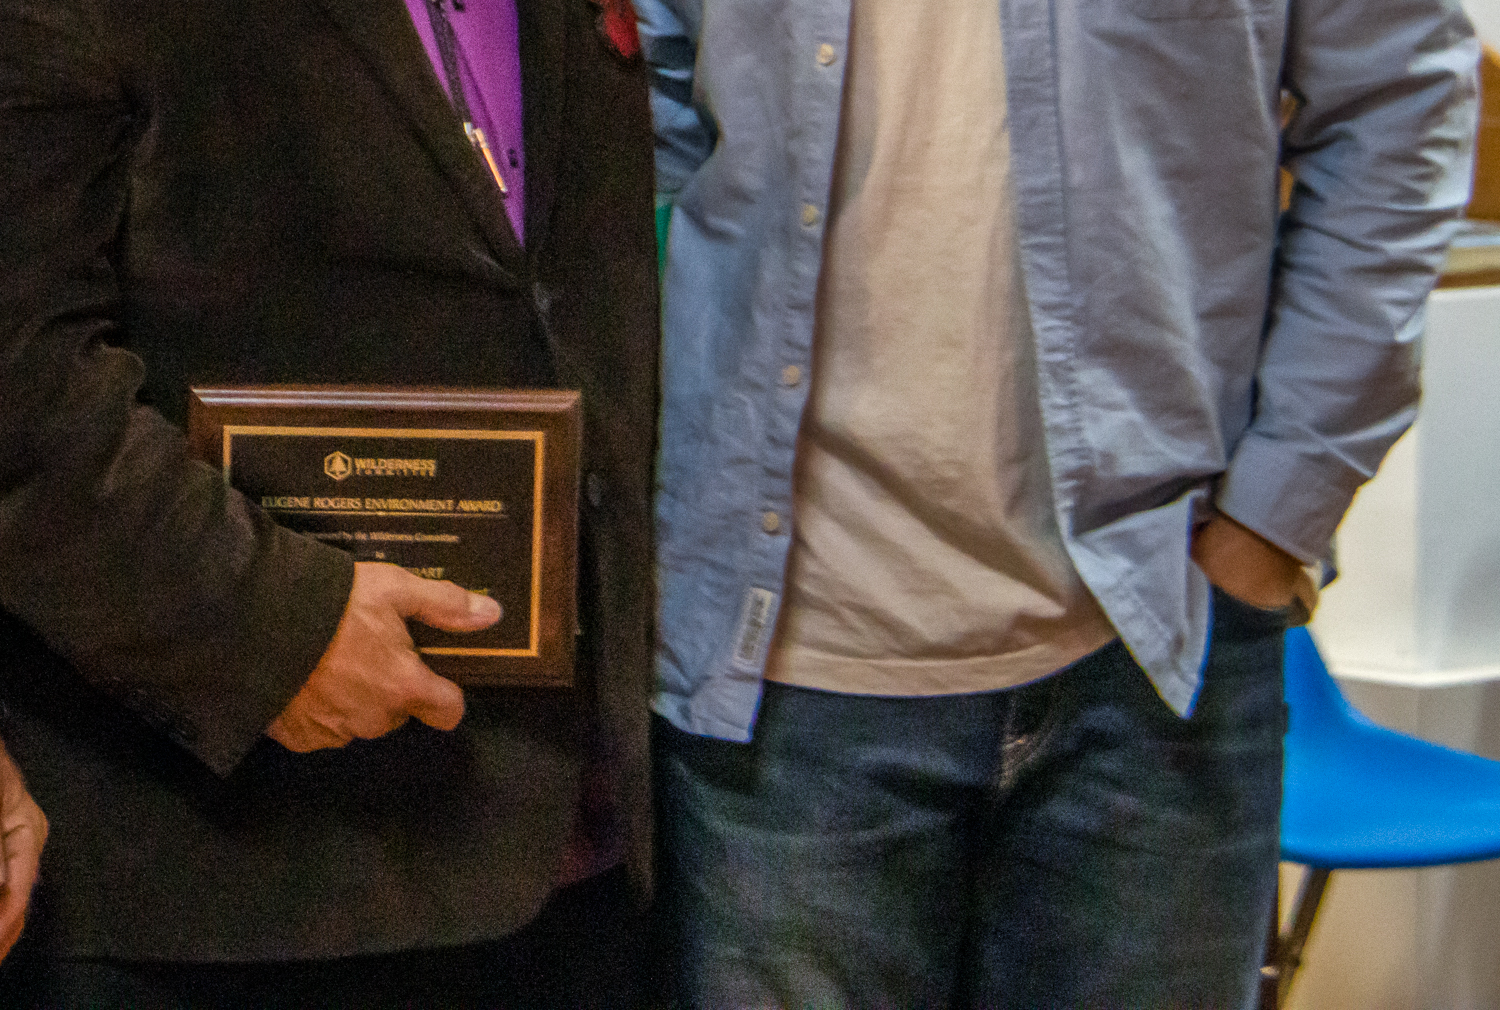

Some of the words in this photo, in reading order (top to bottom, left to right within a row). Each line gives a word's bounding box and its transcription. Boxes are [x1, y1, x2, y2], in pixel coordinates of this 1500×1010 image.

[354, 458, 436, 470] WILDERNESS
[261, 496, 311, 508] EUGENE
[313, 497, 362, 509] ROGERS
[364, 498, 454, 511] ENVIRONMENT
[456, 499, 502, 512] AWARD
